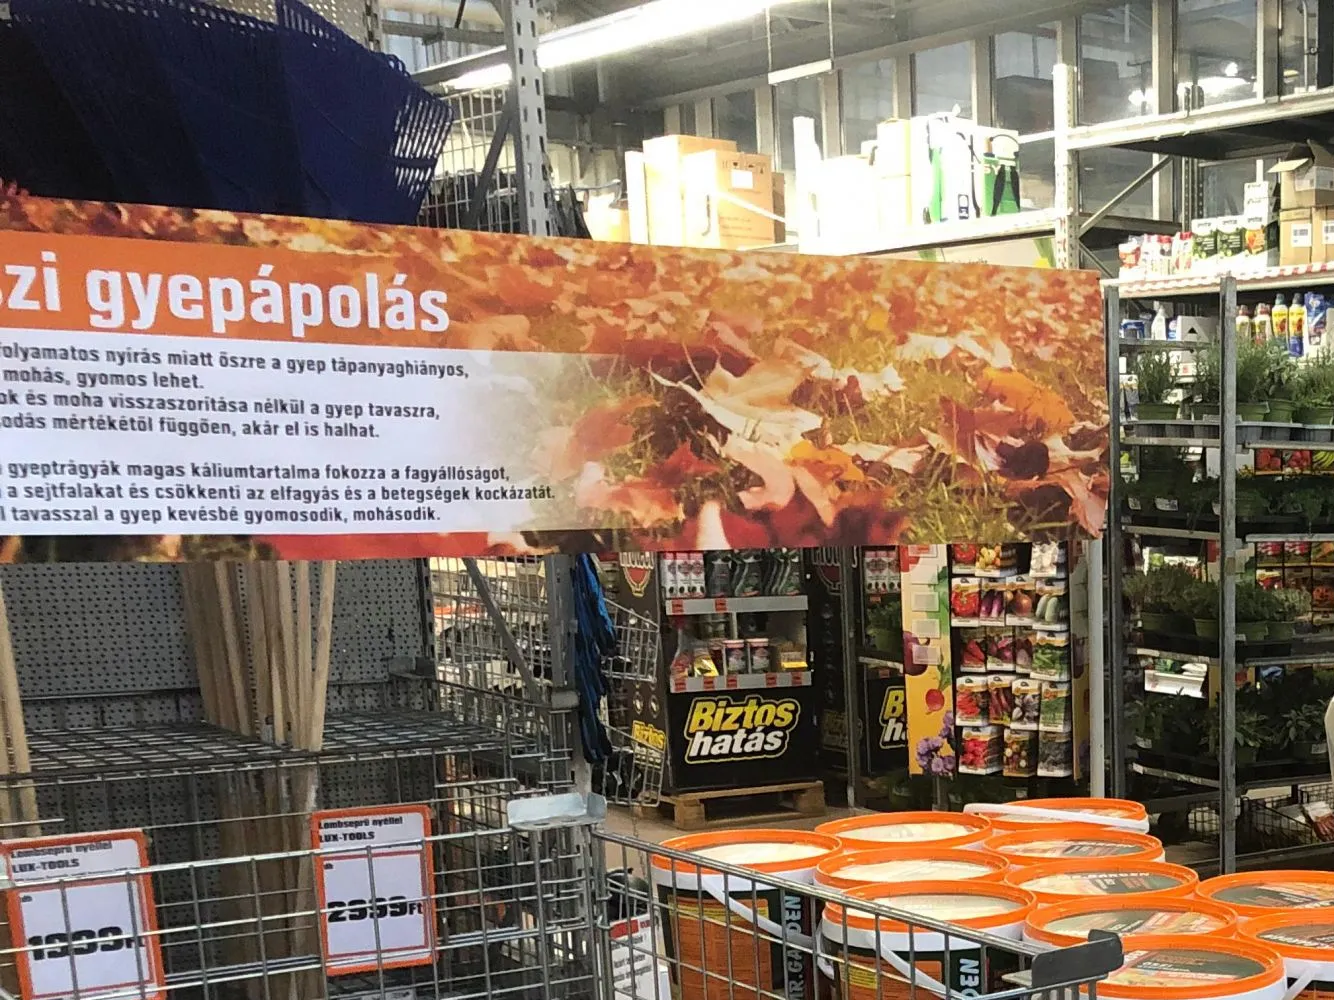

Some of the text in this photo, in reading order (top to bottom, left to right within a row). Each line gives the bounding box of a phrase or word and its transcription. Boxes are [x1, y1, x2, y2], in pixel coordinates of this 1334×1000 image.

[0, 252, 450, 337] zi gyepápolás
[106, 348, 161, 366] nyírás
[168, 351, 213, 367] miatt
[219, 352, 265, 368] őszre
[272, 358, 281, 369] a
[287, 358, 326, 374] gyep
[332, 357, 468, 379] tápanyaghiányos,
[4, 367, 204, 389] mohás, gyomos lehet.
[26, 390, 47, 406] és
[54, 393, 103, 407] moha
[109, 393, 248, 413] visszaszorítása
[254, 399, 304, 414] nélkül
[311, 405, 319, 414] a
[325, 403, 363, 418] gyep
[369, 403, 440, 420] tavaszra,
[0, 413, 379, 437] odás mértékétől függően, akár el is halhat.
[8, 459, 509, 482] gyeptrágyák magas káliumtartalma fokozza a fagyállóságot,
[8, 483, 555, 503] a sejtfalakat és csökkenti az elfagyás és a betegségek kockázatát.
[12, 506, 98, 521] tavasszal
[104, 510, 114, 521] a
[121, 509, 161, 524] gyep
[167, 506, 239, 521] kevésbé
[245, 507, 348, 524] gyomosodik,
[353, 506, 441, 521] mohásodik.
[689, 699, 799, 734] Biztos
[690, 726, 784, 758] hatás
